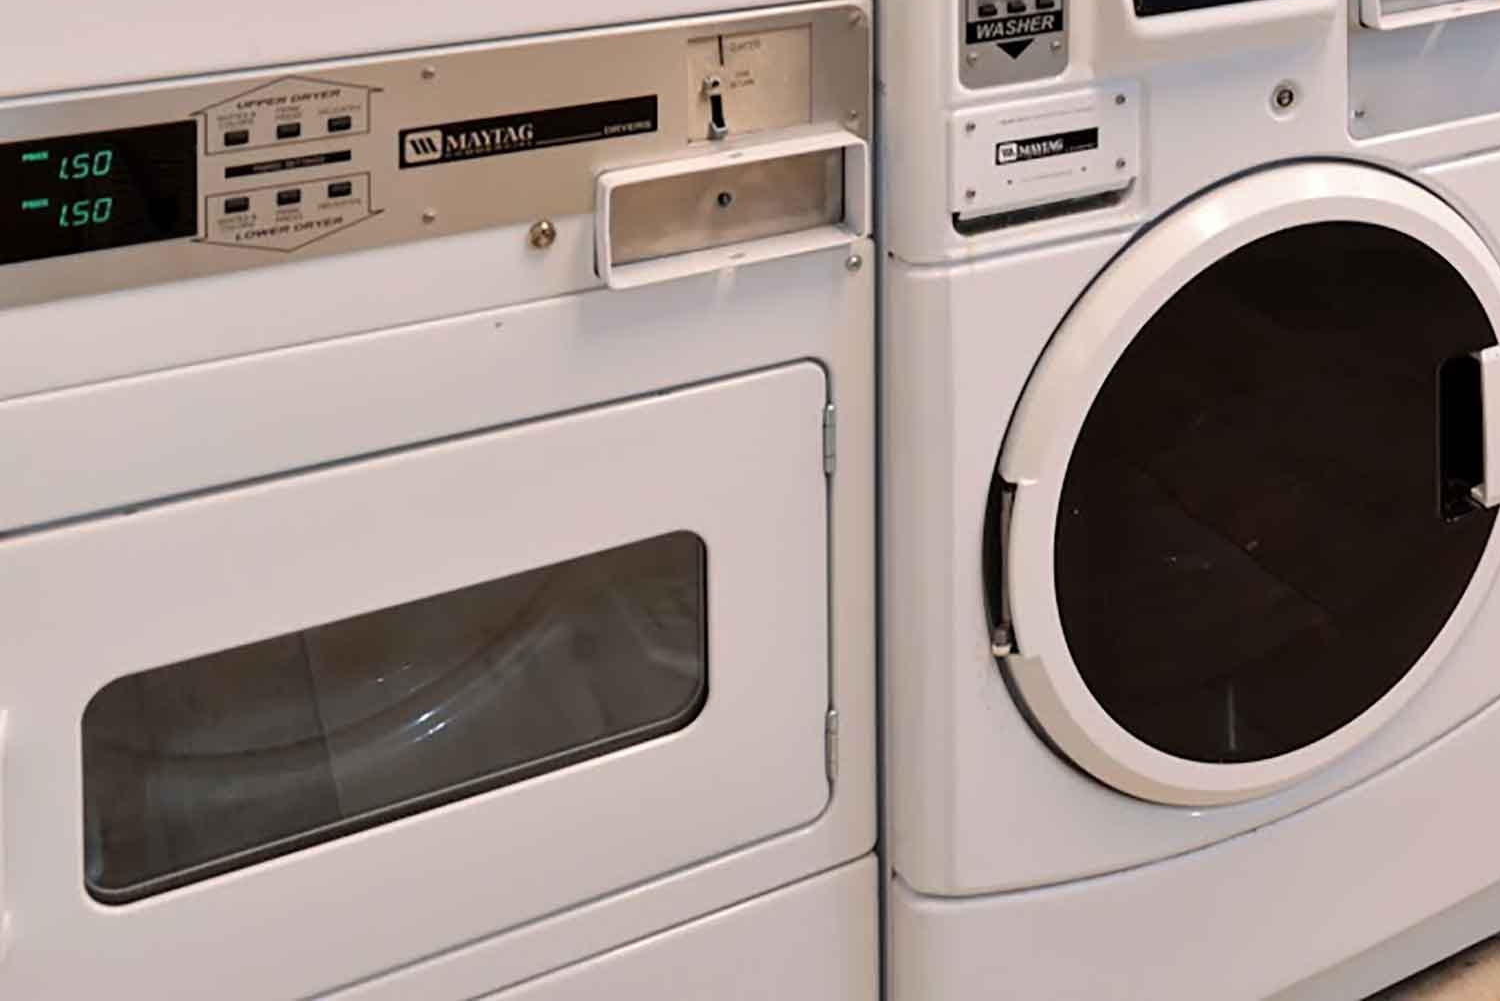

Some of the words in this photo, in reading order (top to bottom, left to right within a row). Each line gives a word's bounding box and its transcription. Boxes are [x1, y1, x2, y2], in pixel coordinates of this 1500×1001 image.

[976, 14, 1055, 39] WASHER
[236, 96, 287, 110] UPPER
[291, 88, 342, 103] DRYER
[446, 123, 534, 151] MAYTAG
[235, 224, 290, 241] LOWER
[294, 215, 343, 232] DRYER
